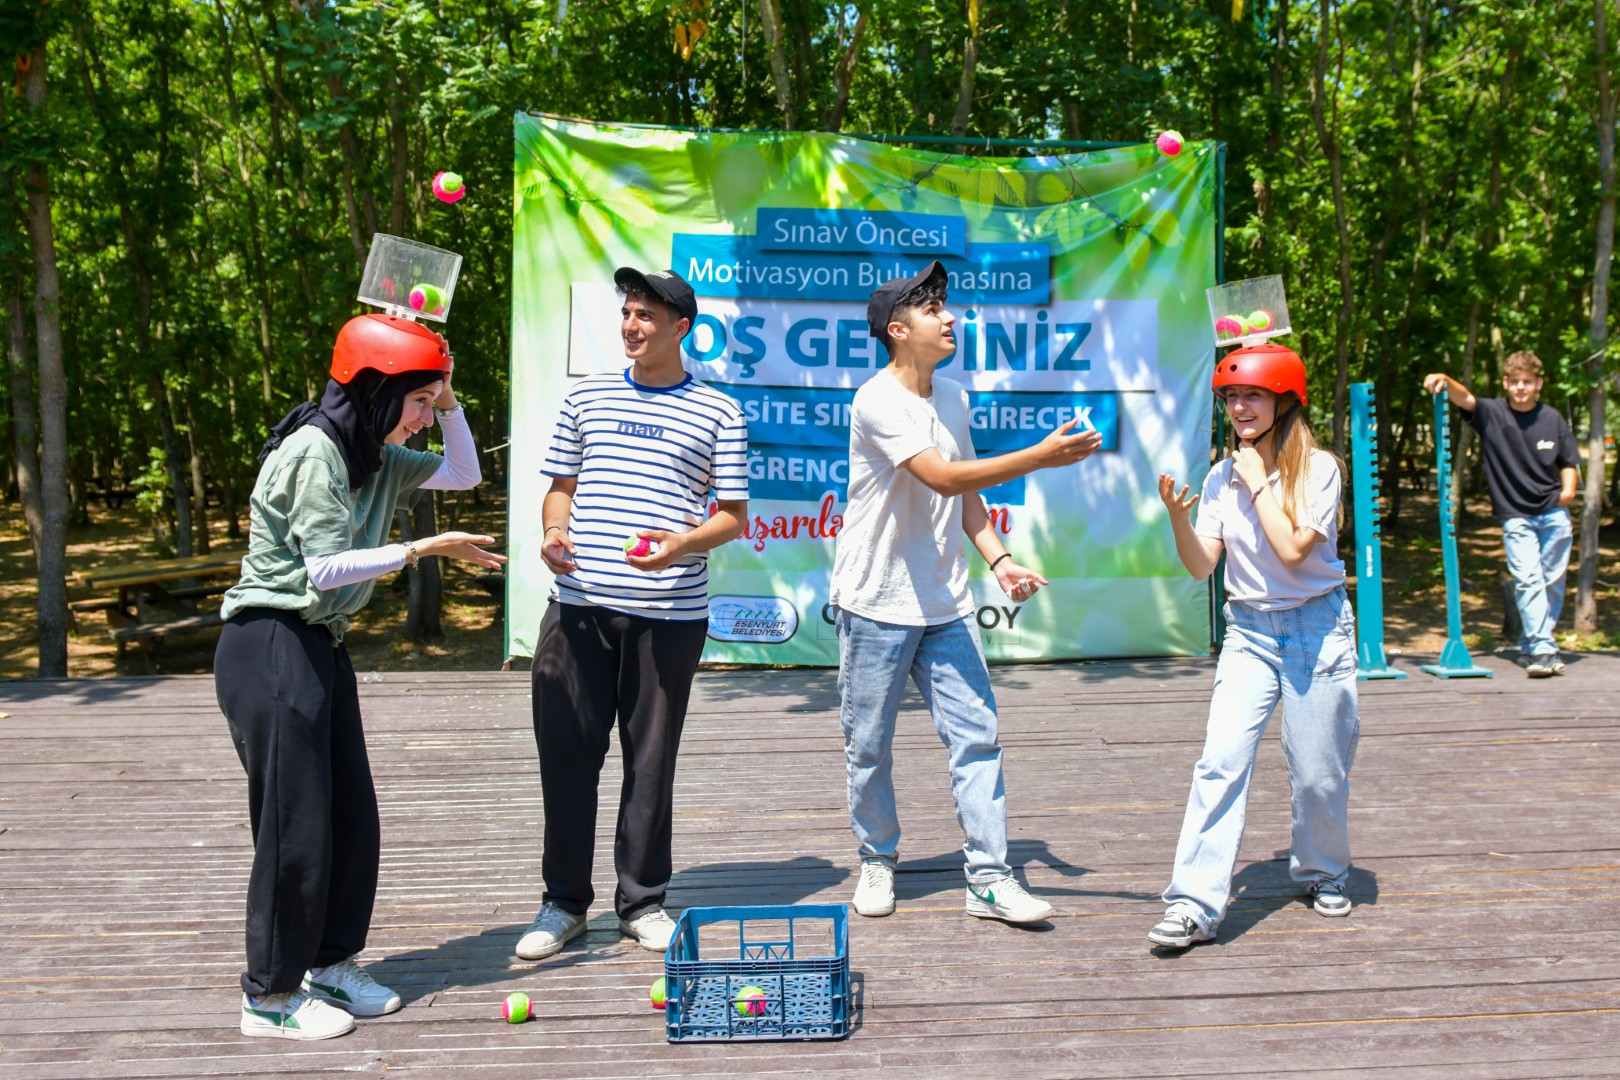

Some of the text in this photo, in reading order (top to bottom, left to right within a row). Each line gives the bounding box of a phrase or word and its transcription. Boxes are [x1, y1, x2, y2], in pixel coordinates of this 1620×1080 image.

[774, 216, 948, 247] Sınav Öncesi
[688, 257, 848, 291] Motivasyon
[681, 309, 1092, 379] OŞ GEİNİZ
[969, 401, 1094, 430] GİRECEK
[731, 627, 787, 637] BELEDİYESİ
[734, 620, 787, 629] ESENYURT
